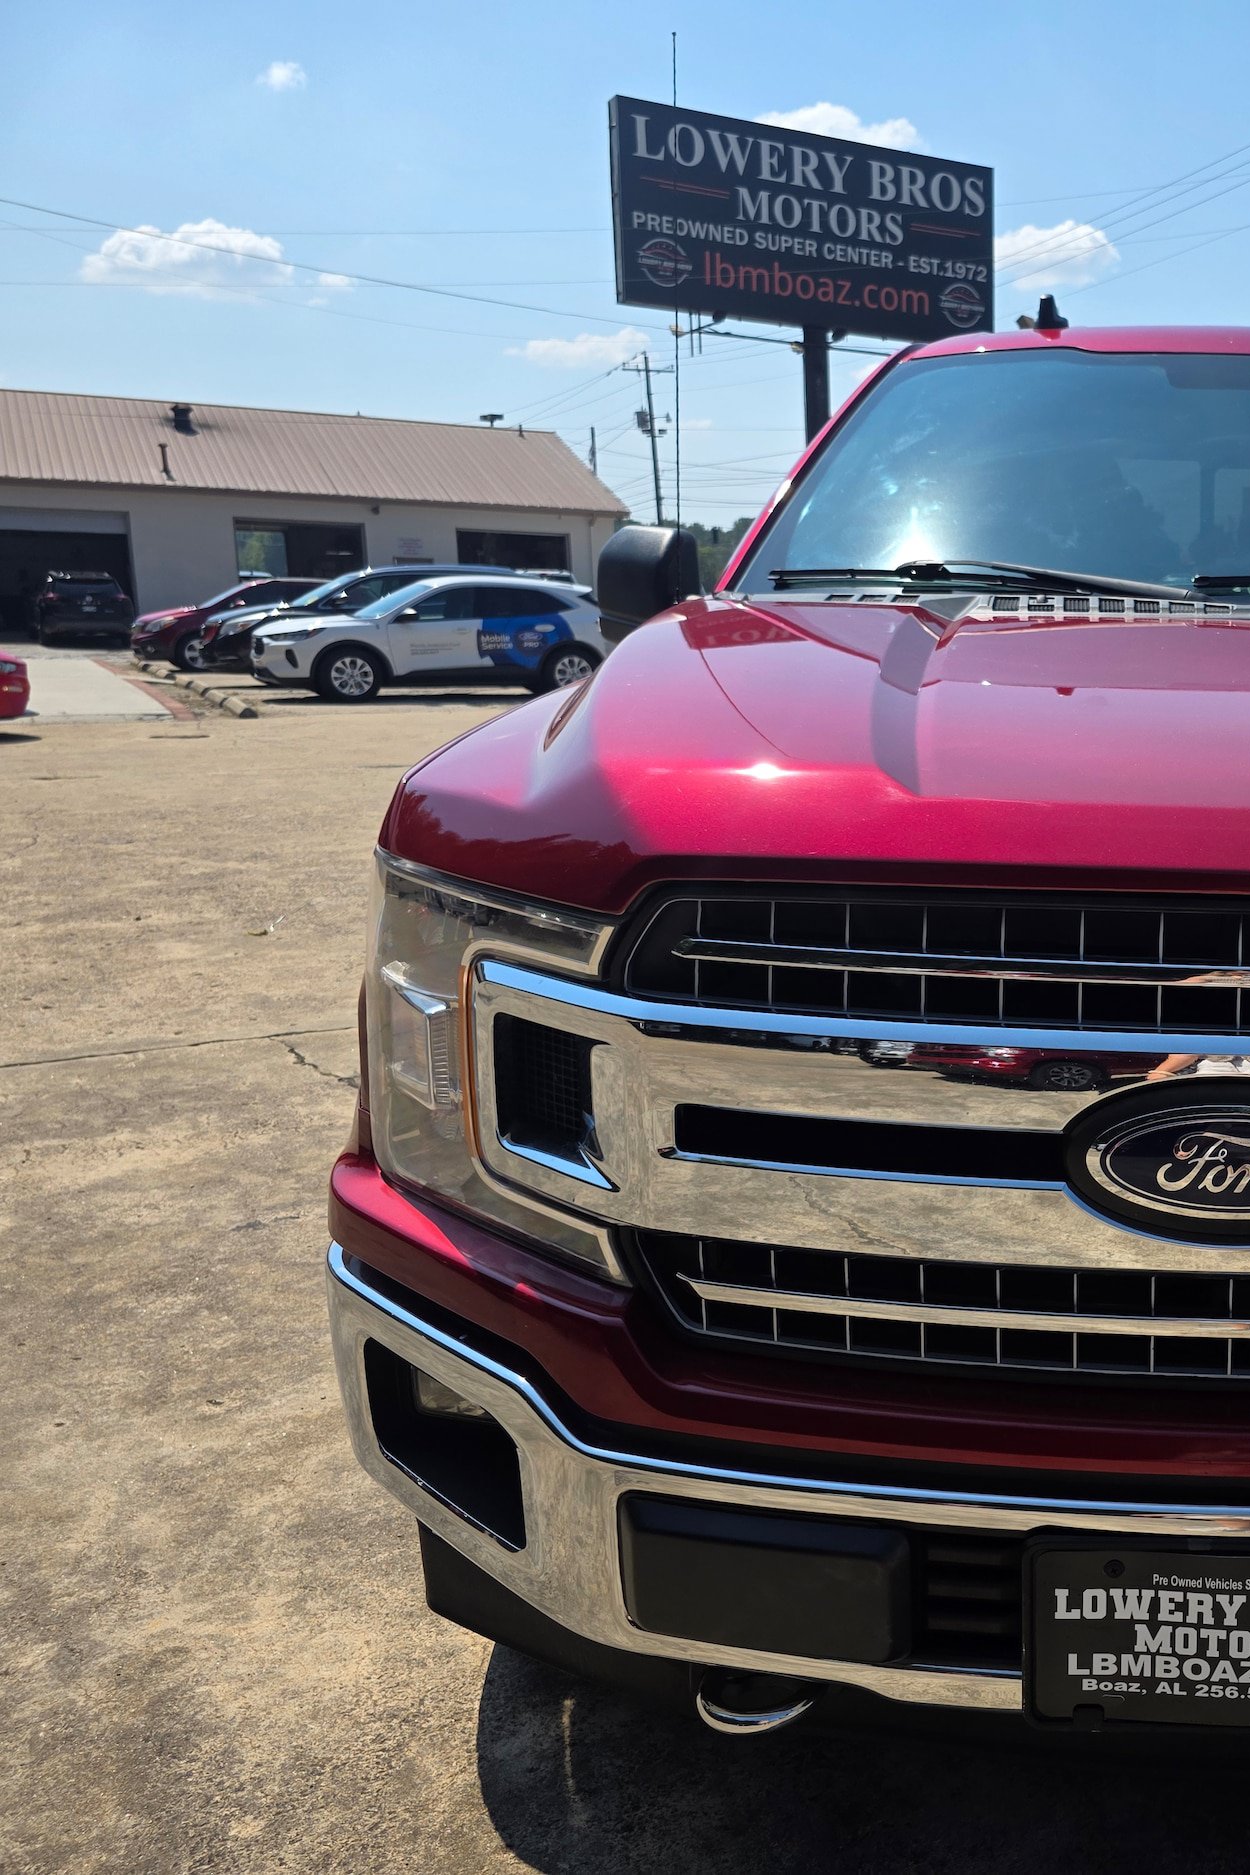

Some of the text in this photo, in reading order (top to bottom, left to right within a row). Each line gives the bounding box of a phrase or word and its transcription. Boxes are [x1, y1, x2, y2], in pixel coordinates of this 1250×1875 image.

[630, 114, 985, 218] LOWERY BROS
[734, 186, 905, 246] MOTORS
[632, 211, 749, 246] PREOWNED
[753, 231, 818, 258] SUPER
[822, 242, 893, 269] CENTER
[908, 255, 988, 282] EST.1972
[704, 250, 930, 316] lbmboaz.com
[481, 634, 511, 643] Mobile
[481, 642, 514, 650] Service
[1152, 1574, 1169, 1587] Pre
[1170, 1575, 1203, 1589] Owned
[1204, 1576, 1242, 1590] Vehicles
[1054, 1588, 1247, 1626] LOWERY
[1081, 1678, 1147, 1695] Boaz,
[1155, 1682, 1187, 1696] AL
